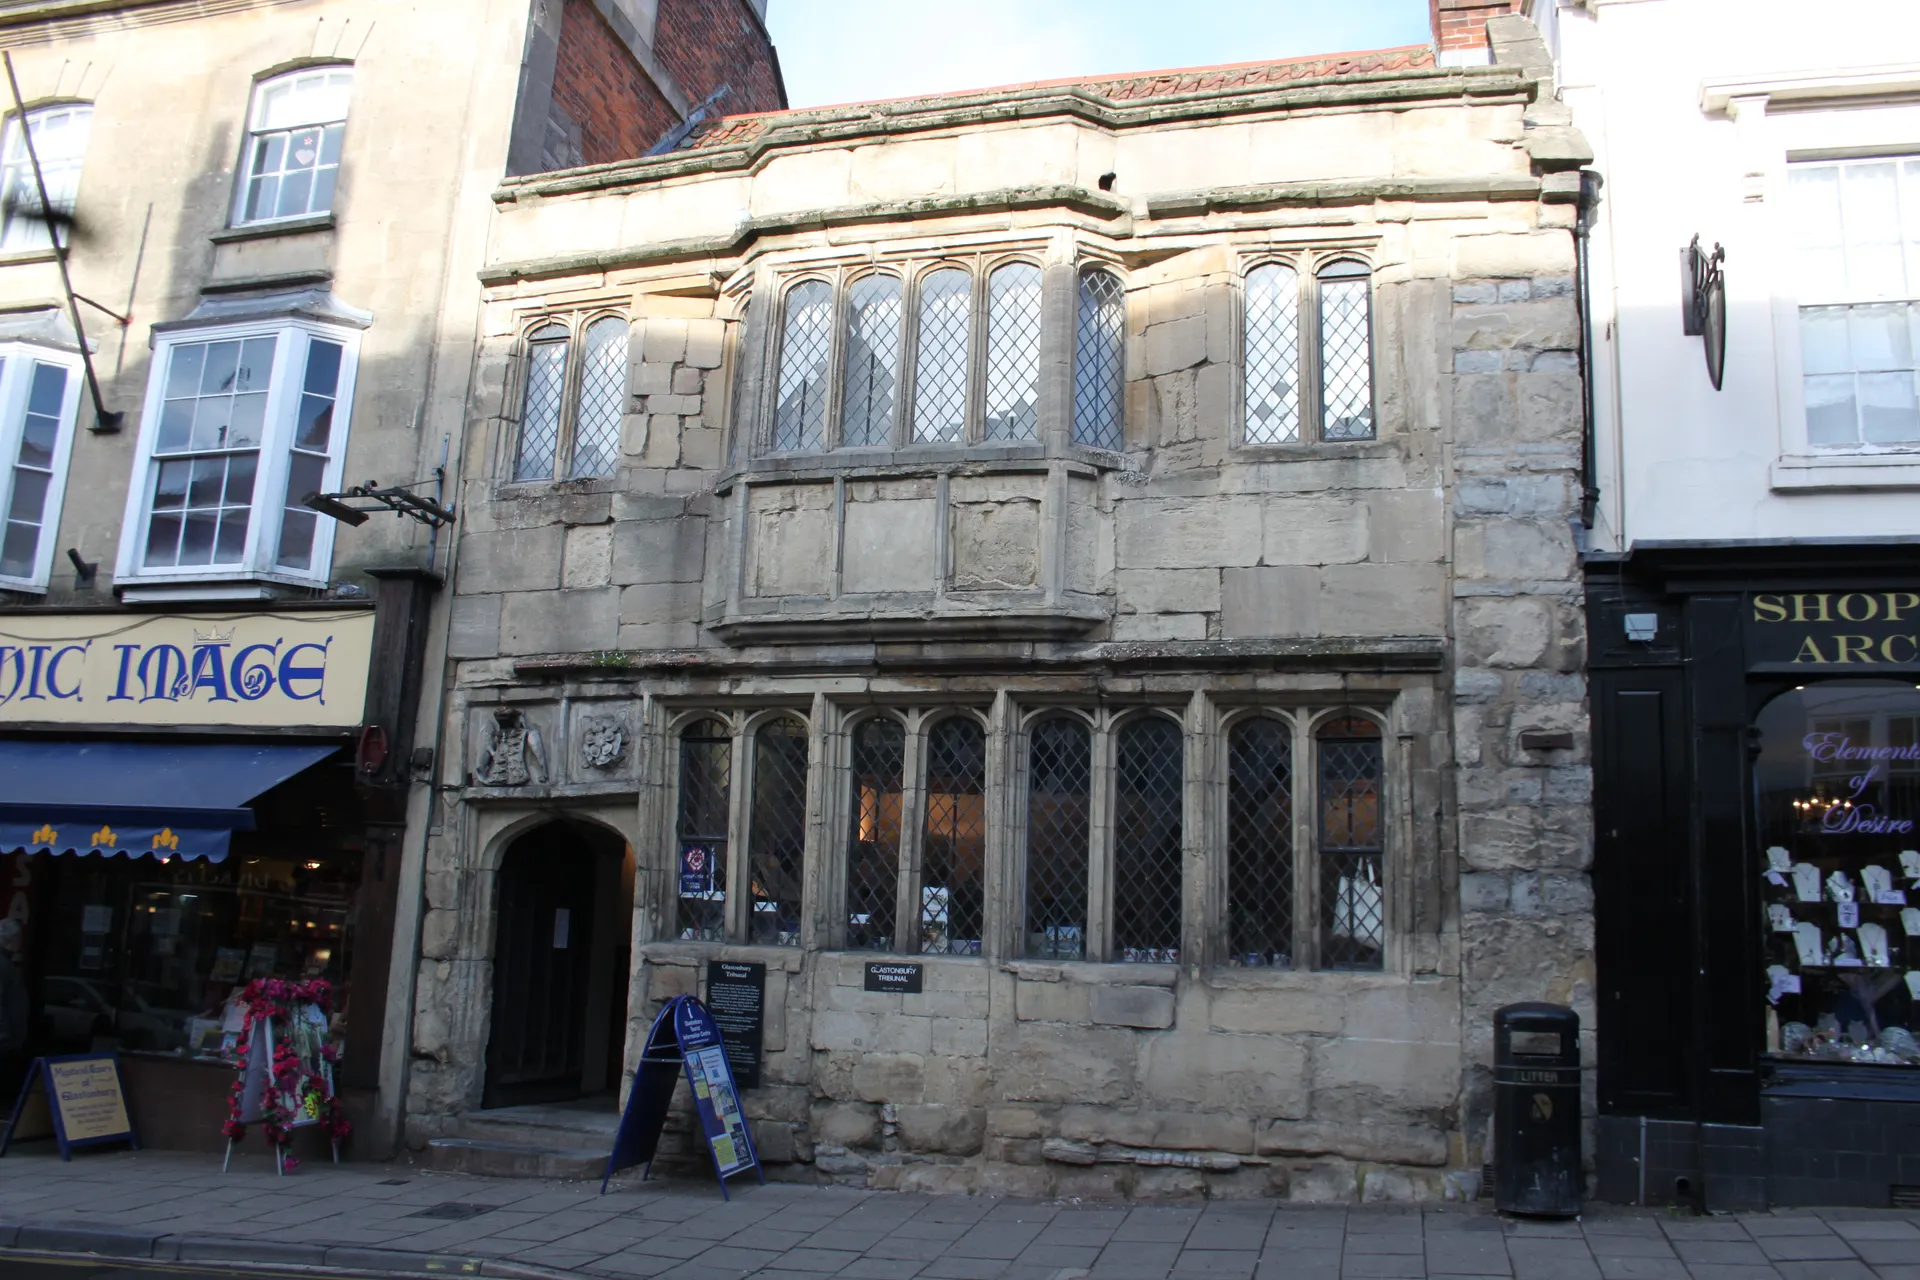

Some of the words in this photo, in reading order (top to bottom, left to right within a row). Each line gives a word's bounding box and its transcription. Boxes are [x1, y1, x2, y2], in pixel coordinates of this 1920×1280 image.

[1753, 592, 1920, 622] SHOP
[107, 635, 334, 706] IMAGE
[1847, 764, 1881, 799] of
[1820, 803, 1914, 834] Desire
[871, 966, 916, 974] GLASTONBURY
[1520, 1070, 1559, 1083] LITTER
